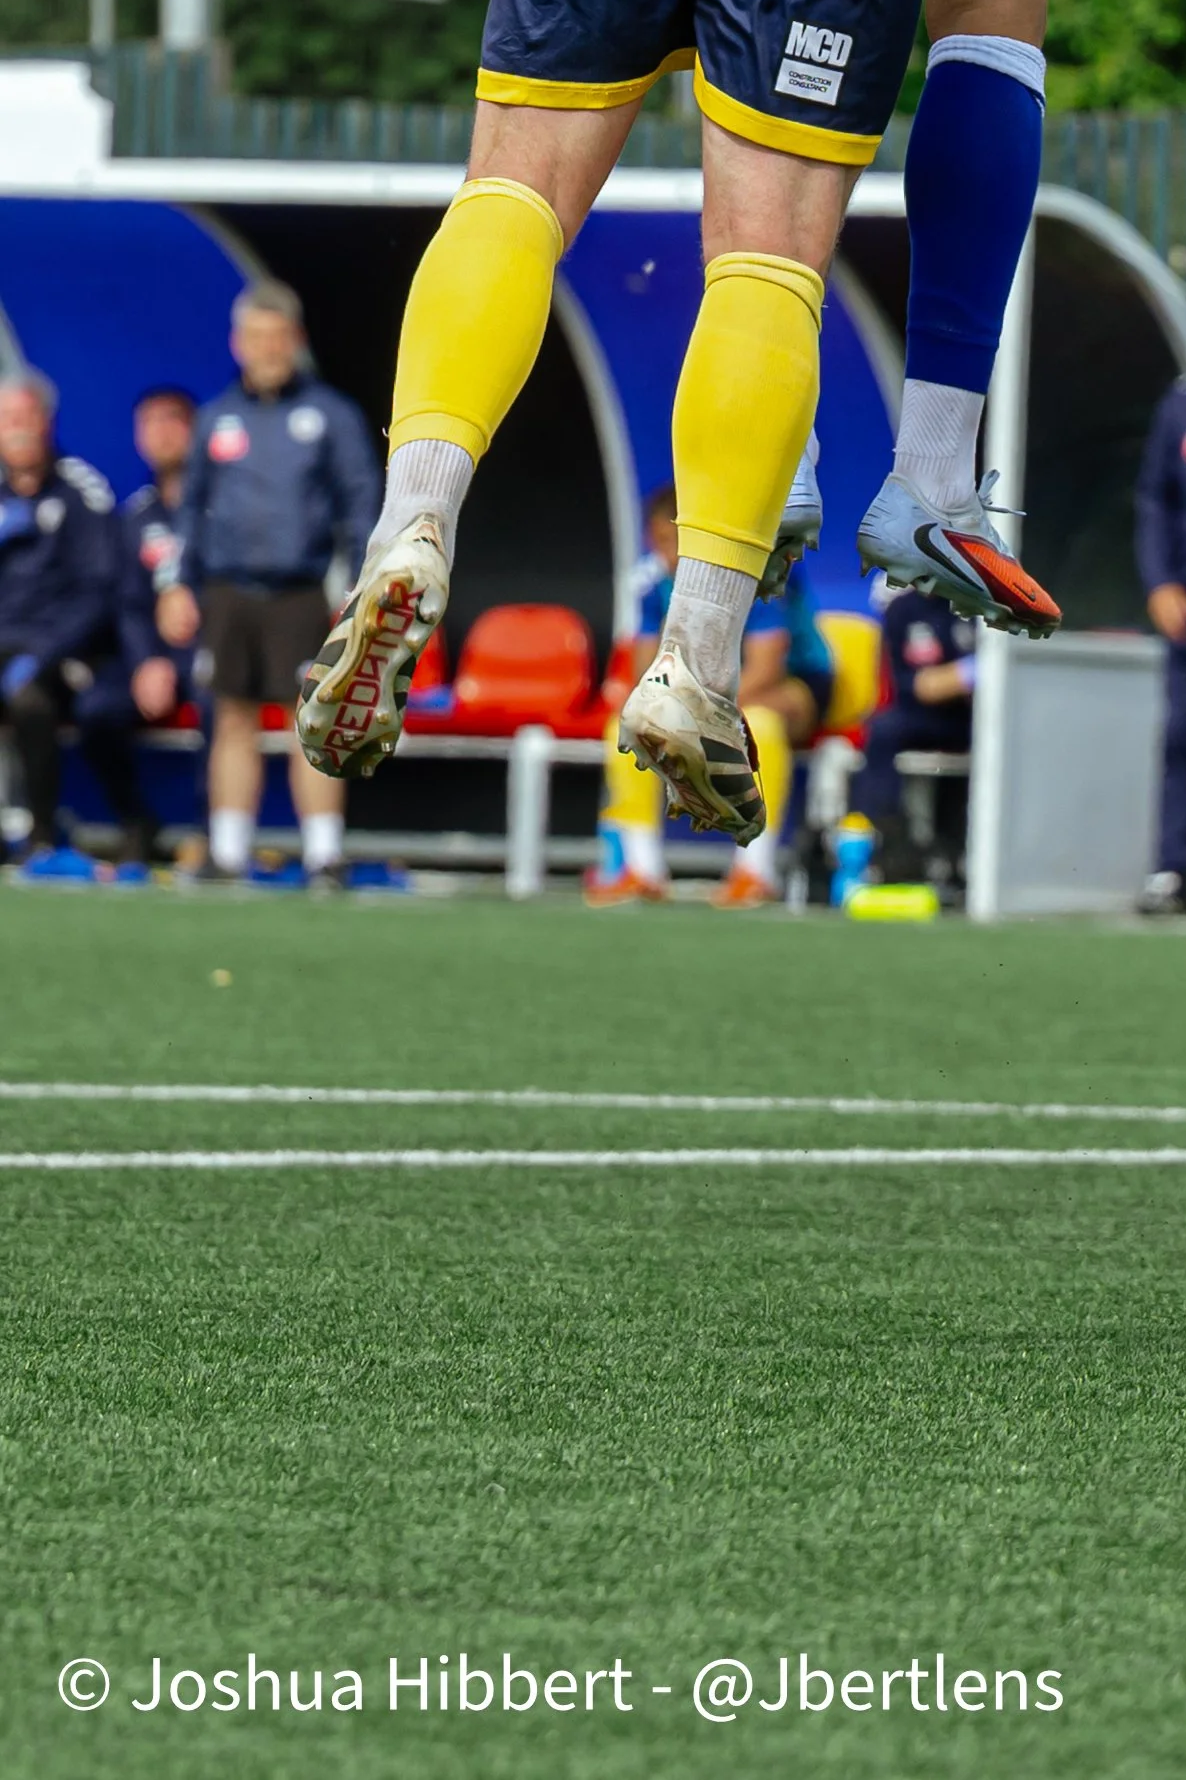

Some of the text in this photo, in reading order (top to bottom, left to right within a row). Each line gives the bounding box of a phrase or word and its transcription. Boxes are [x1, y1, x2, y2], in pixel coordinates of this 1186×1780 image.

[784, 20, 853, 67] MCD
[788, 70, 832, 86] CONSTRUCTION
[788, 78, 828, 93] CONSULTANCY
